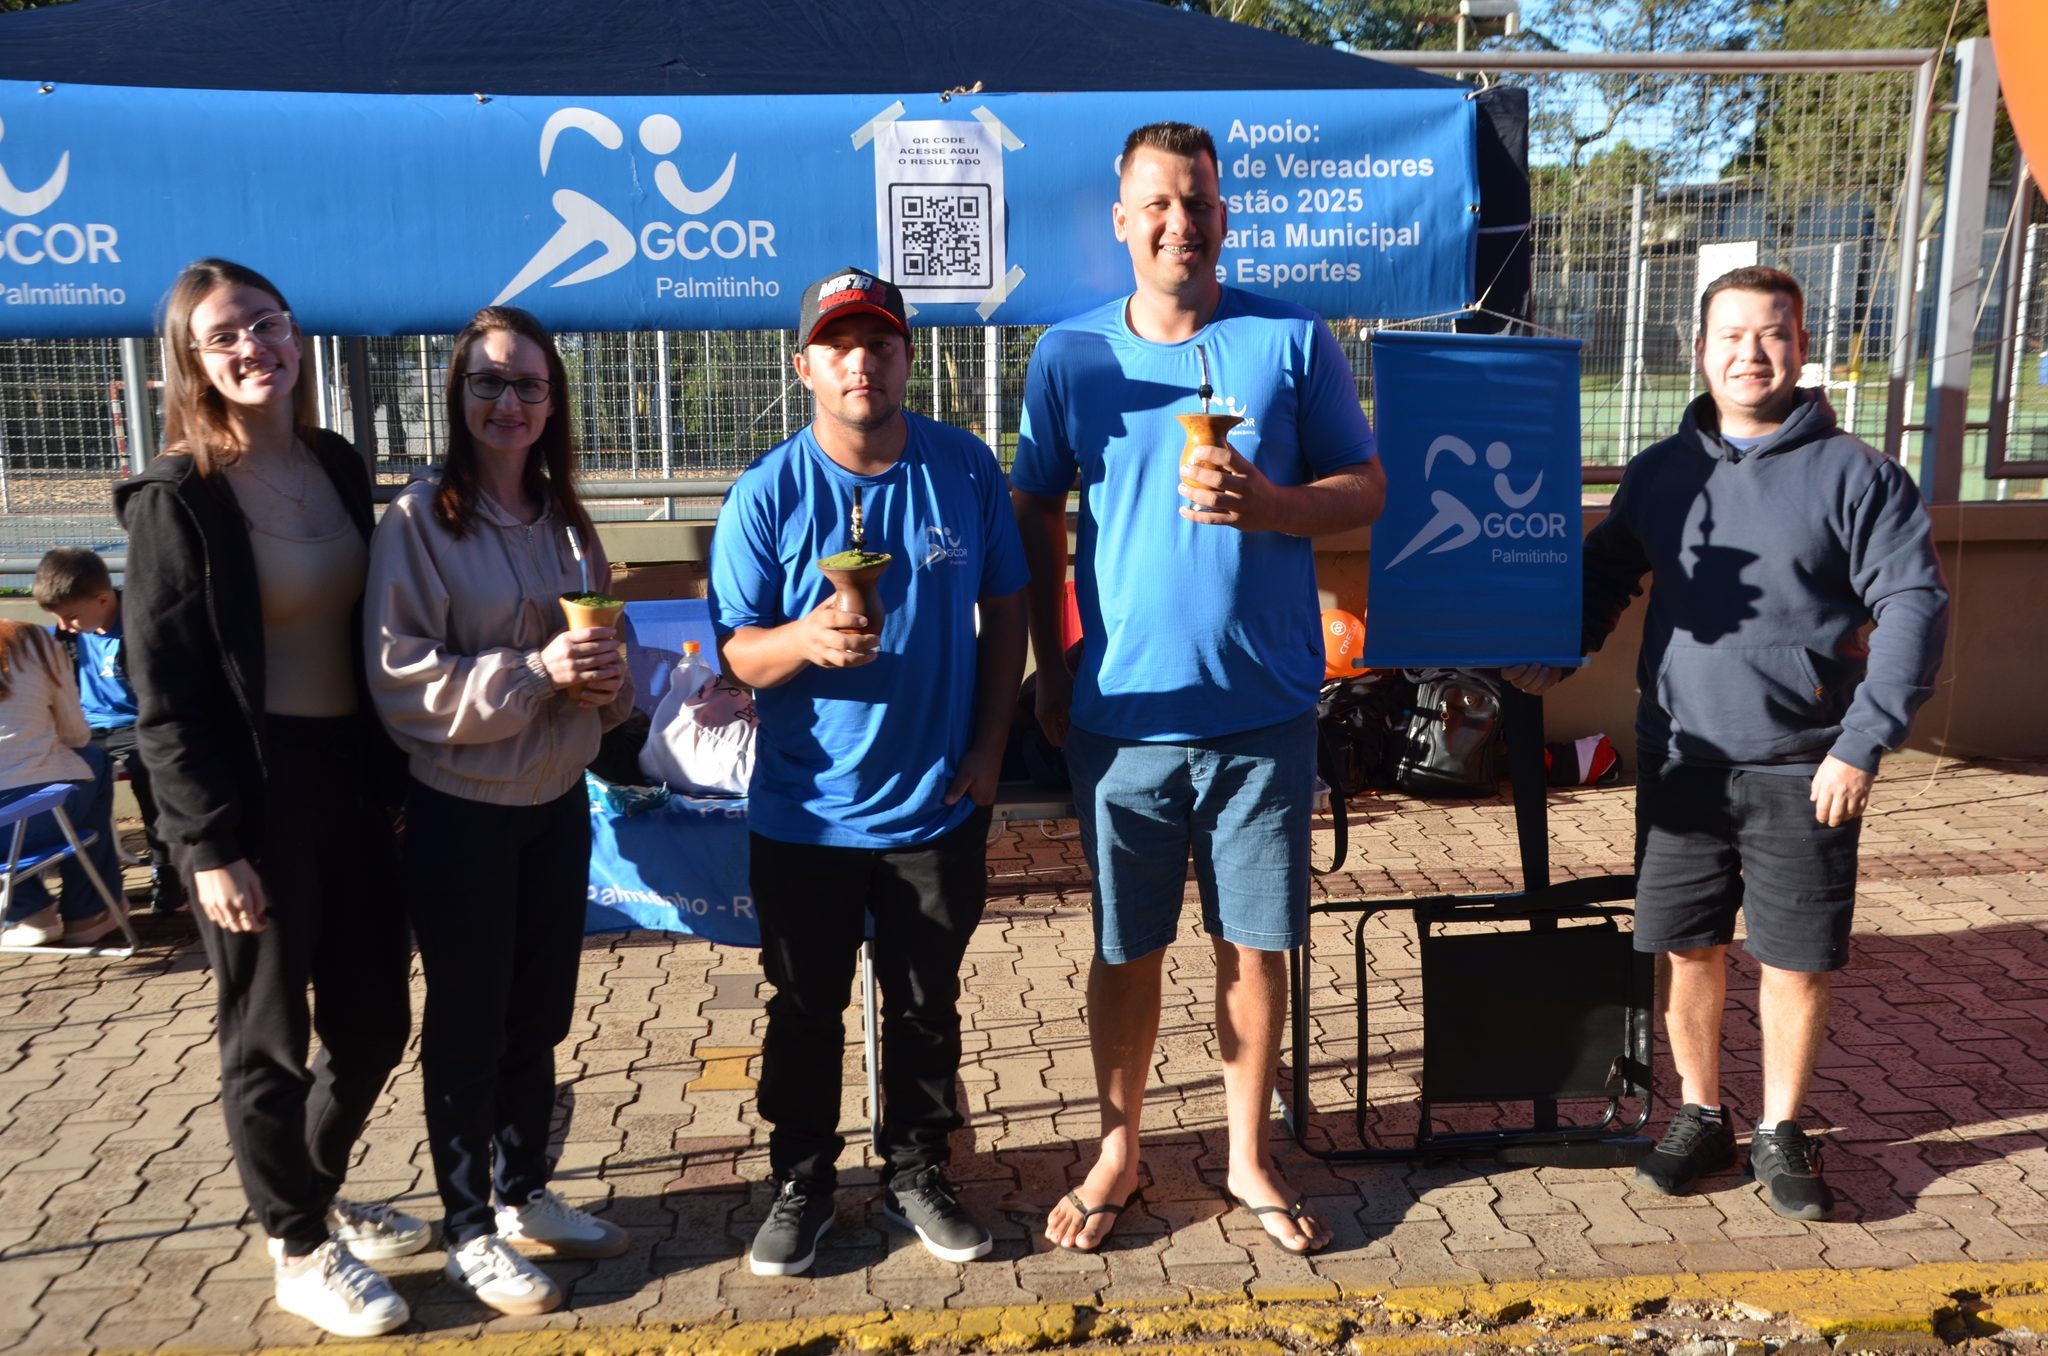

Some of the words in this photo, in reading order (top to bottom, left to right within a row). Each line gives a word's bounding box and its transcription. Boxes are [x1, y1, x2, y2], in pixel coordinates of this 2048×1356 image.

[1227, 119, 1320, 149] Apoio:
[910, 158, 981, 166] RESULTADO
[1233, 155, 1267, 178] de
[1275, 154, 1435, 179] Vereadores
[1298, 188, 1364, 213] 2025
[0, 222, 121, 266] COR
[640, 220, 777, 261] GCOR
[1285, 222, 1421, 252] Municipal
[656, 276, 780, 298] Palmitinho
[1237, 258, 1361, 289] Esportes
[1483, 512, 1567, 539] GCOR
[1492, 548, 1568, 563] Palmitinho
